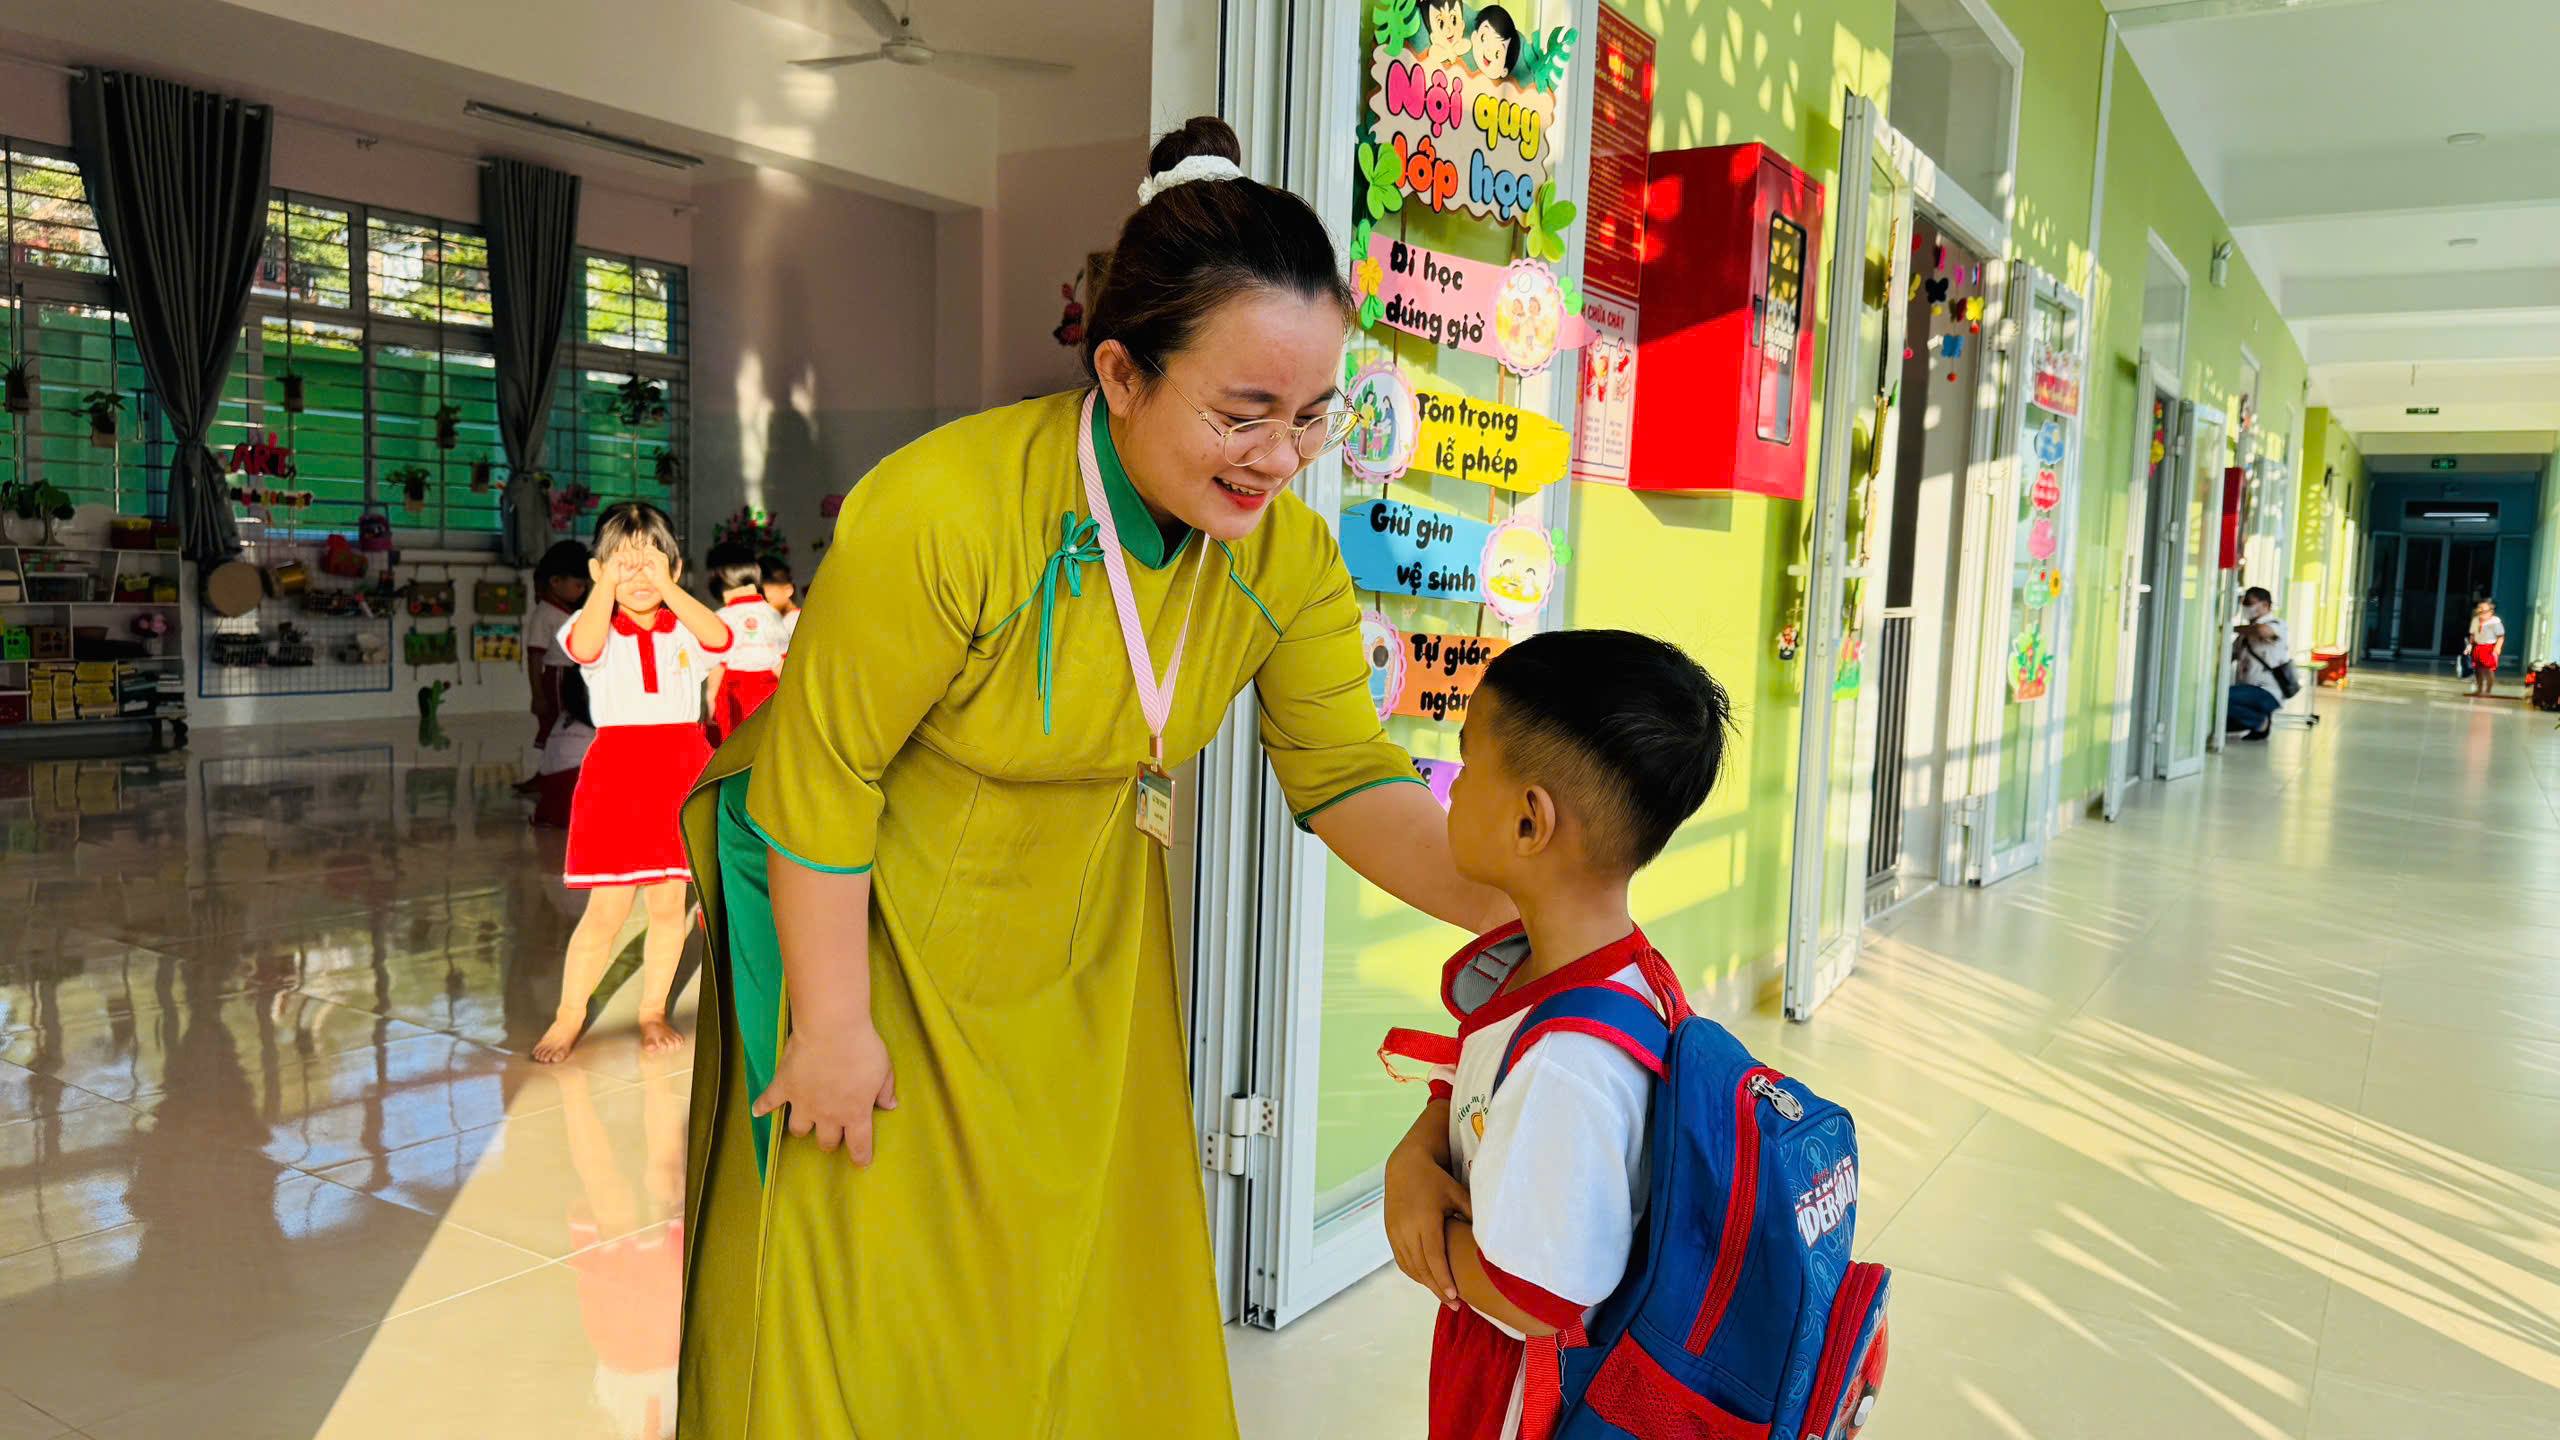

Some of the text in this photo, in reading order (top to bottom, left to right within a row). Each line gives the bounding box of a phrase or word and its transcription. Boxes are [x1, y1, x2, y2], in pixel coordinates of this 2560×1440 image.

[1385, 60, 1541, 161] Nội quy
[1392, 131, 1533, 221] lớp học
[1390, 240, 1464, 294] Đi học
[1385, 293, 1486, 350] đúng giờ
[1418, 392, 1519, 442] Tôn trọng
[1435, 438, 1519, 484] lễ phép
[1370, 503, 1454, 550] Giữ gìn
[1396, 564, 1476, 597] vệ sinh
[1410, 633, 1492, 677] Tự giác
